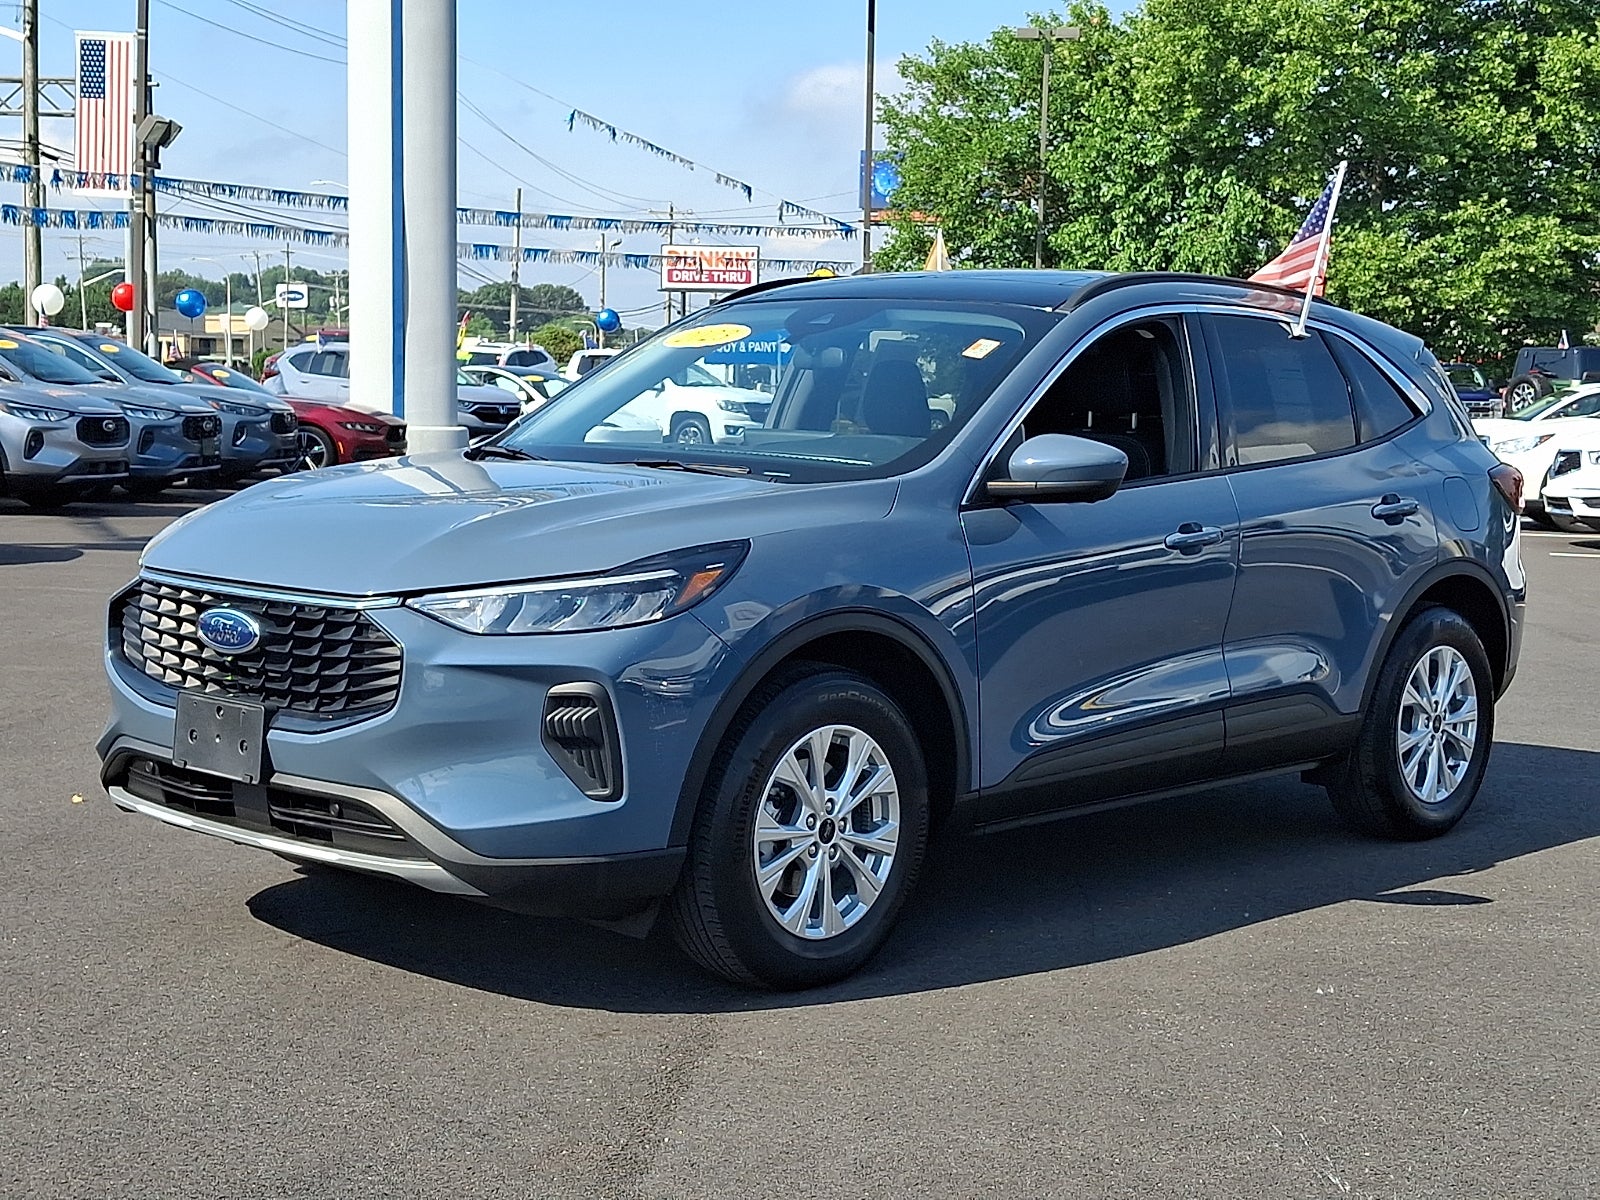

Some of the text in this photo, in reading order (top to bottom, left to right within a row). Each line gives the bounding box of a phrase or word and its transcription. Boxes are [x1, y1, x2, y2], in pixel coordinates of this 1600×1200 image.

[668, 250, 755, 268] DUNKIN'
[672, 270, 746, 283] DRIVE THRU
[712, 341, 777, 353] DY & PAINT
